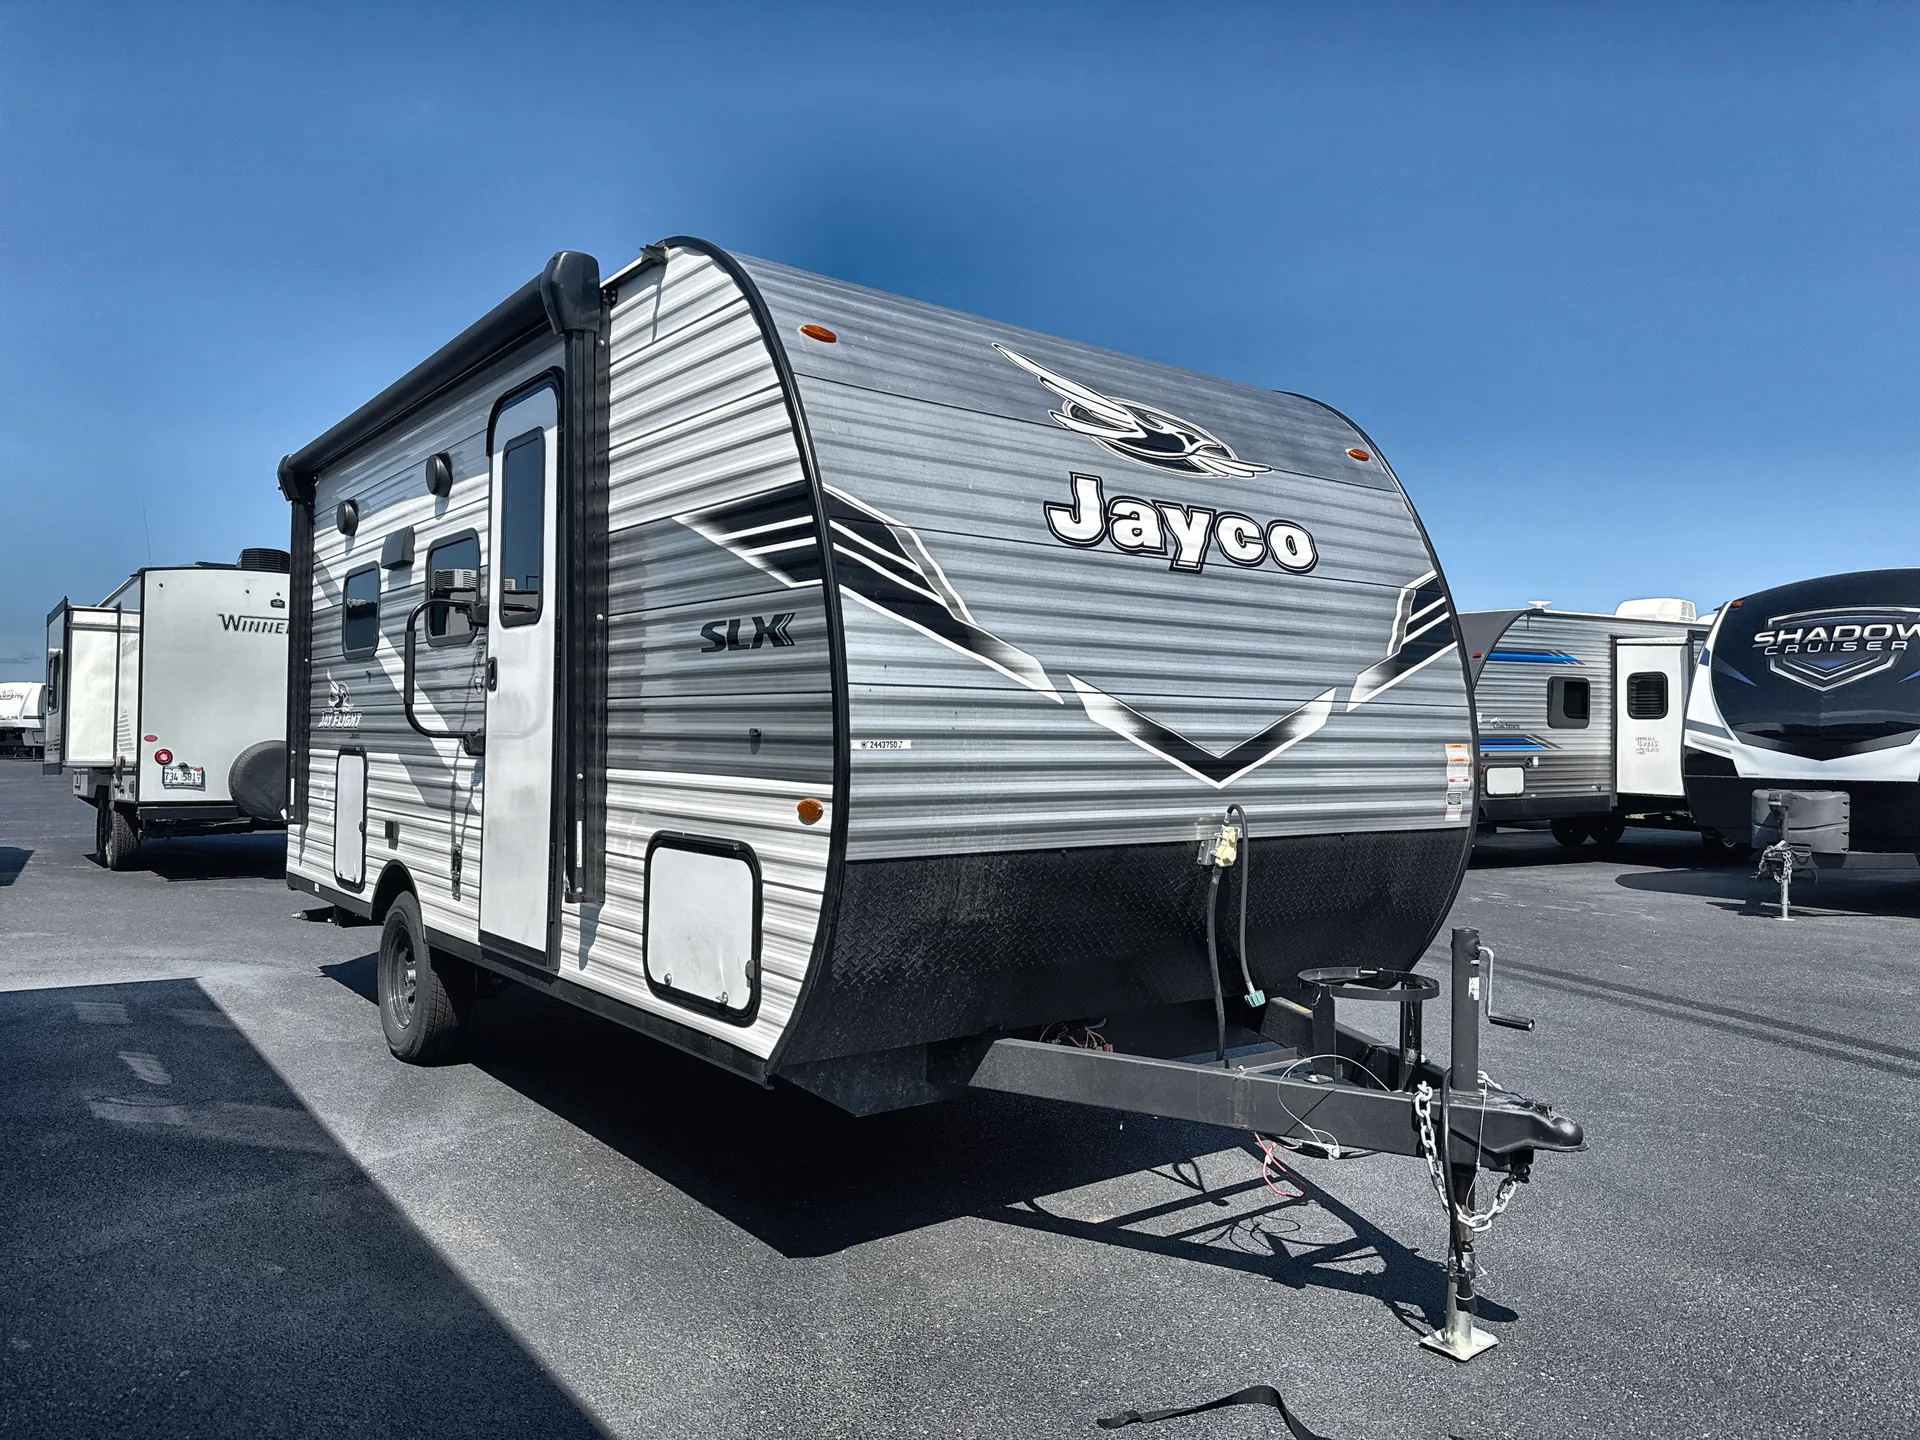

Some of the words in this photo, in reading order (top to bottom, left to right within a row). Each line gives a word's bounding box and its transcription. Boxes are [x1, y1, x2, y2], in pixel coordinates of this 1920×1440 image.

[1043, 471, 1319, 573] Jayco
[217, 613, 289, 634] WINNE
[700, 612, 796, 652] SLX
[1764, 641, 1908, 655] CRUISER
[317, 711, 333, 728] JAY
[331, 711, 363, 728] FLIGHT
